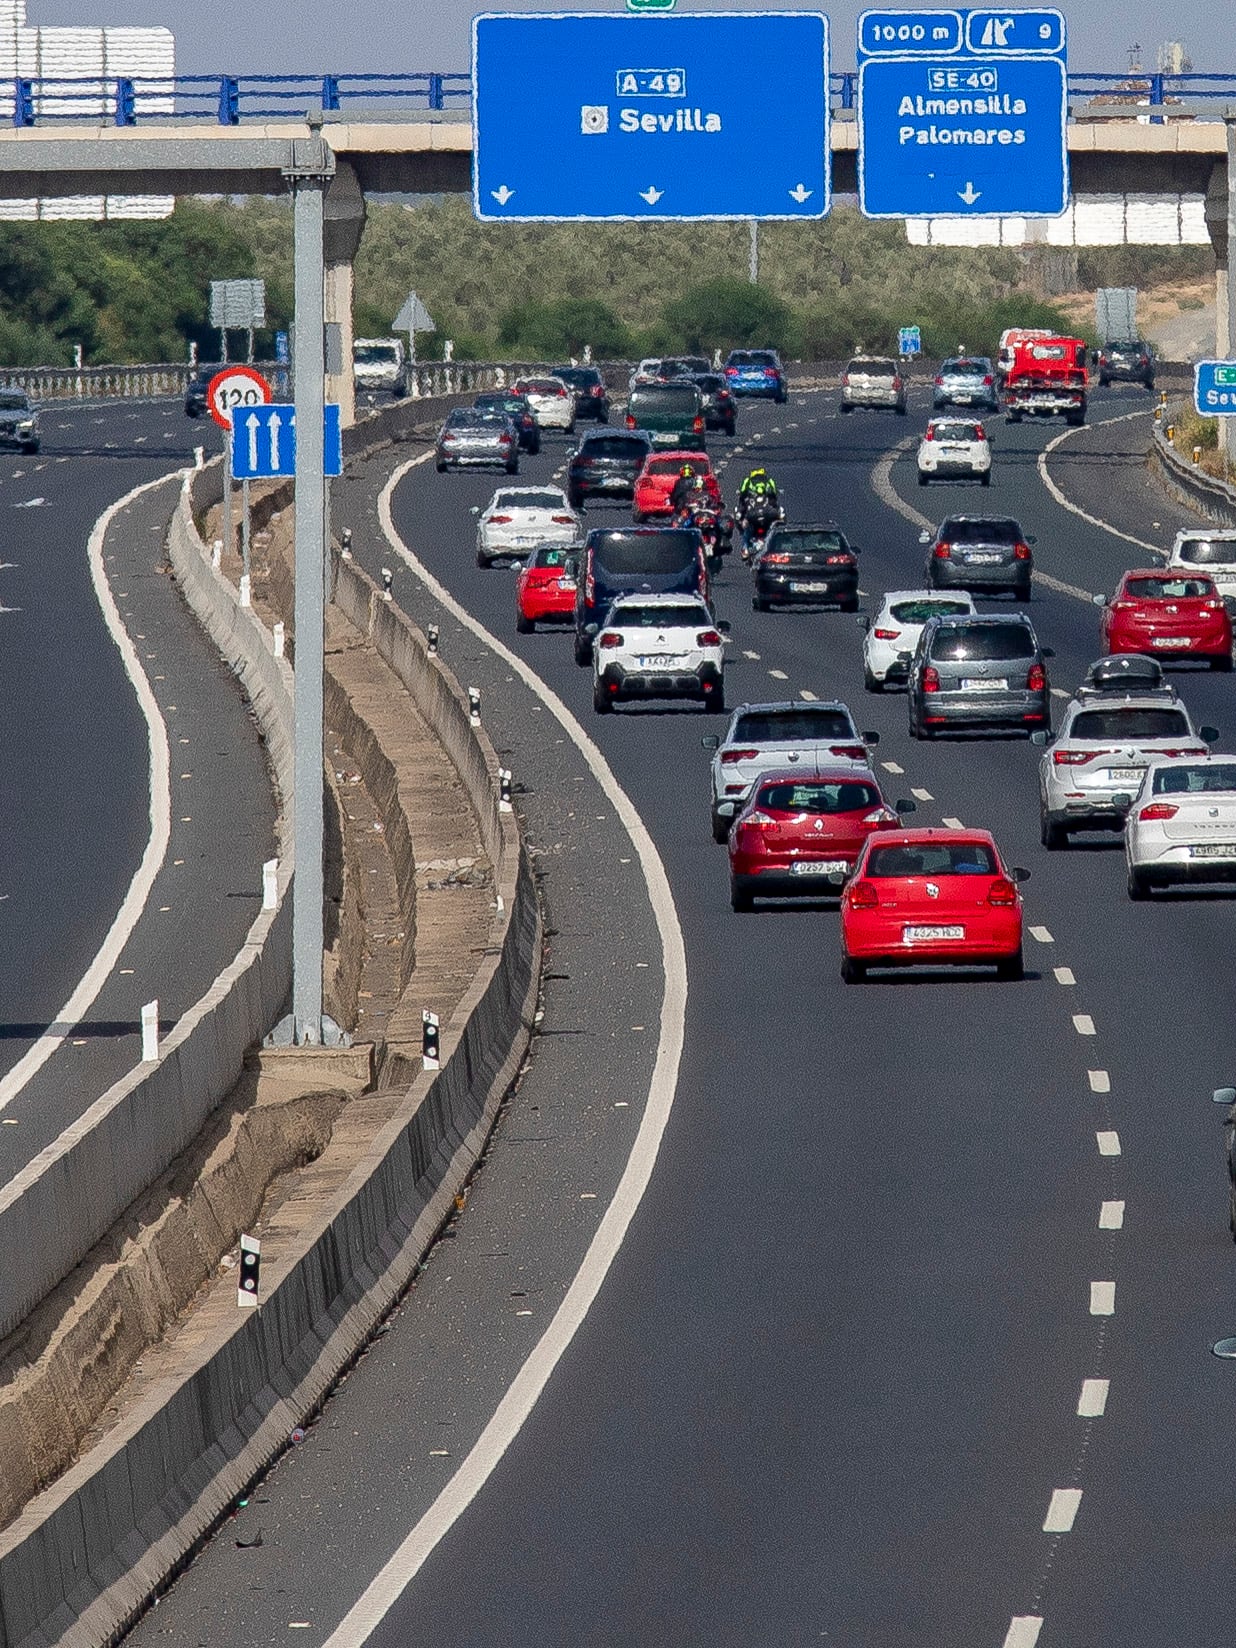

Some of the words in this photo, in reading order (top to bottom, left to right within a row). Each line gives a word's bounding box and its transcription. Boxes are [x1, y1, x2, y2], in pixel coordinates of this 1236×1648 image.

[872, 24, 925, 41] 1000
[932, 27, 949, 39] m
[1039, 23, 1052, 39] 9
[622, 73, 681, 92] A-49
[933, 71, 994, 88] SE-40
[898, 94, 1027, 116] Almensilla
[619, 108, 722, 133] Sevilla
[899, 125, 1026, 145] Palomares
[219, 388, 258, 410] 120
